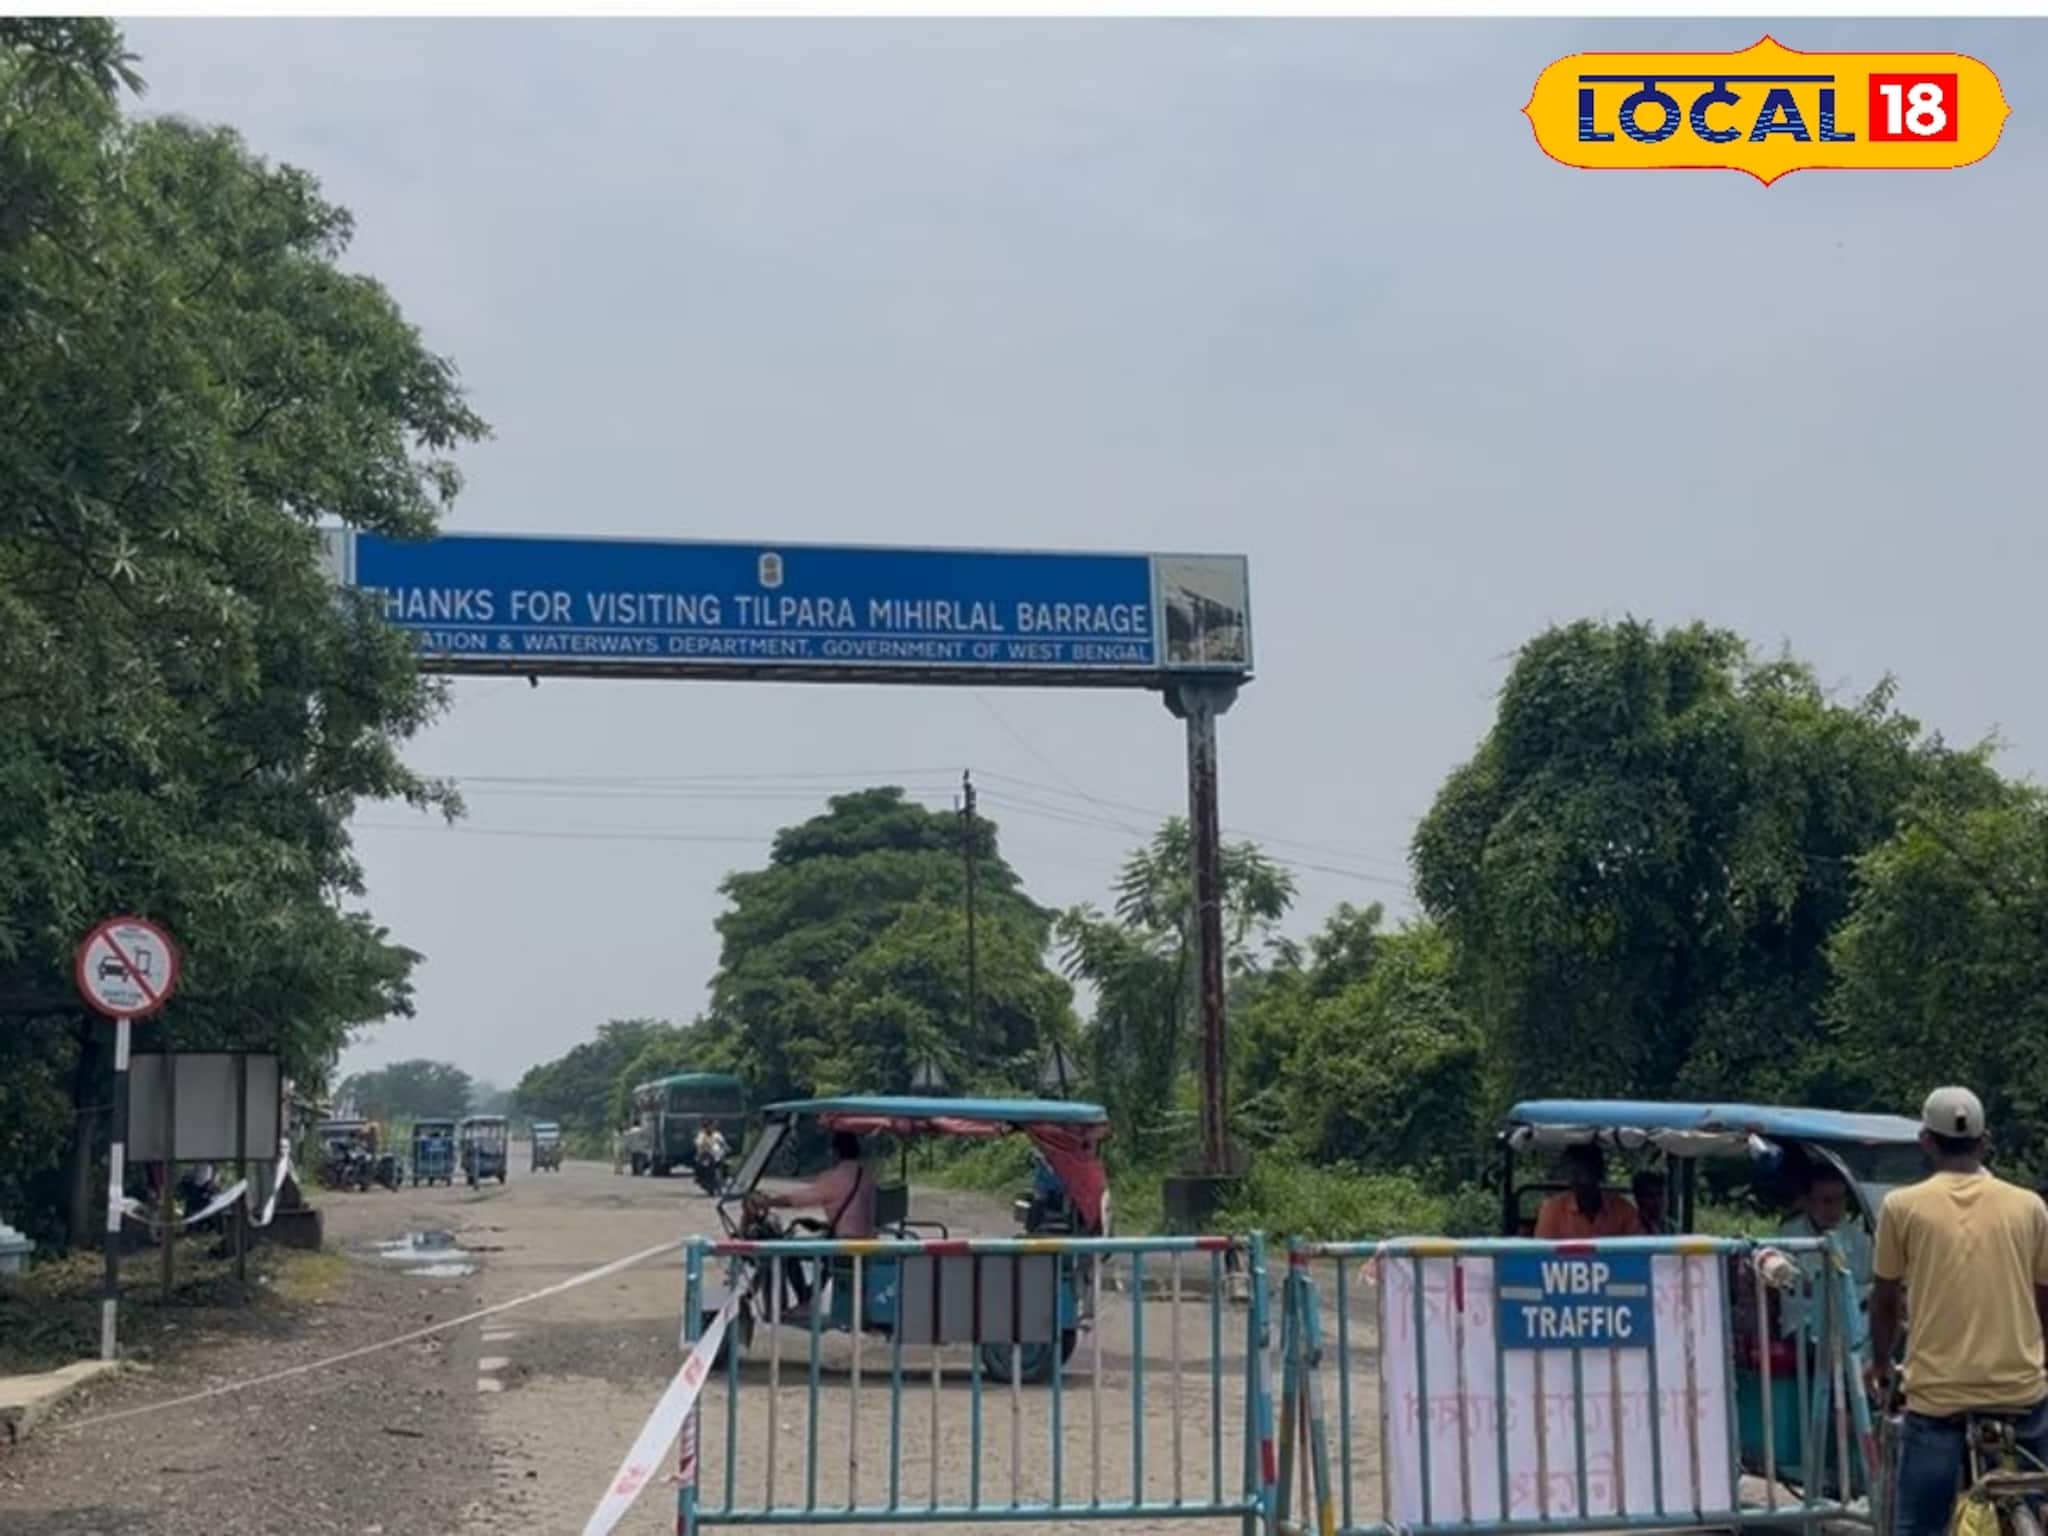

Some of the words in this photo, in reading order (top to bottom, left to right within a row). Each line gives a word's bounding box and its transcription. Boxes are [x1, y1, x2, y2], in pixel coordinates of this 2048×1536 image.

[511, 590, 572, 623] FOR
[587, 592, 721, 625] VISITING
[735, 596, 856, 628] TILPARA
[868, 600, 1005, 631] MIHIRLAL
[1016, 603, 1148, 633] BARRAGE
[497, 635, 514, 650] &
[523, 634, 659, 652] WATERWAYS
[823, 640, 963, 659] GOVERNMENT
[972, 643, 1001, 659] OF
[1007, 644, 1063, 661] WEST
[1072, 646, 1150, 662] BENGAL
[1542, 1261, 1610, 1295] WBP
[1522, 1306, 1633, 1339] TRAFFIC
